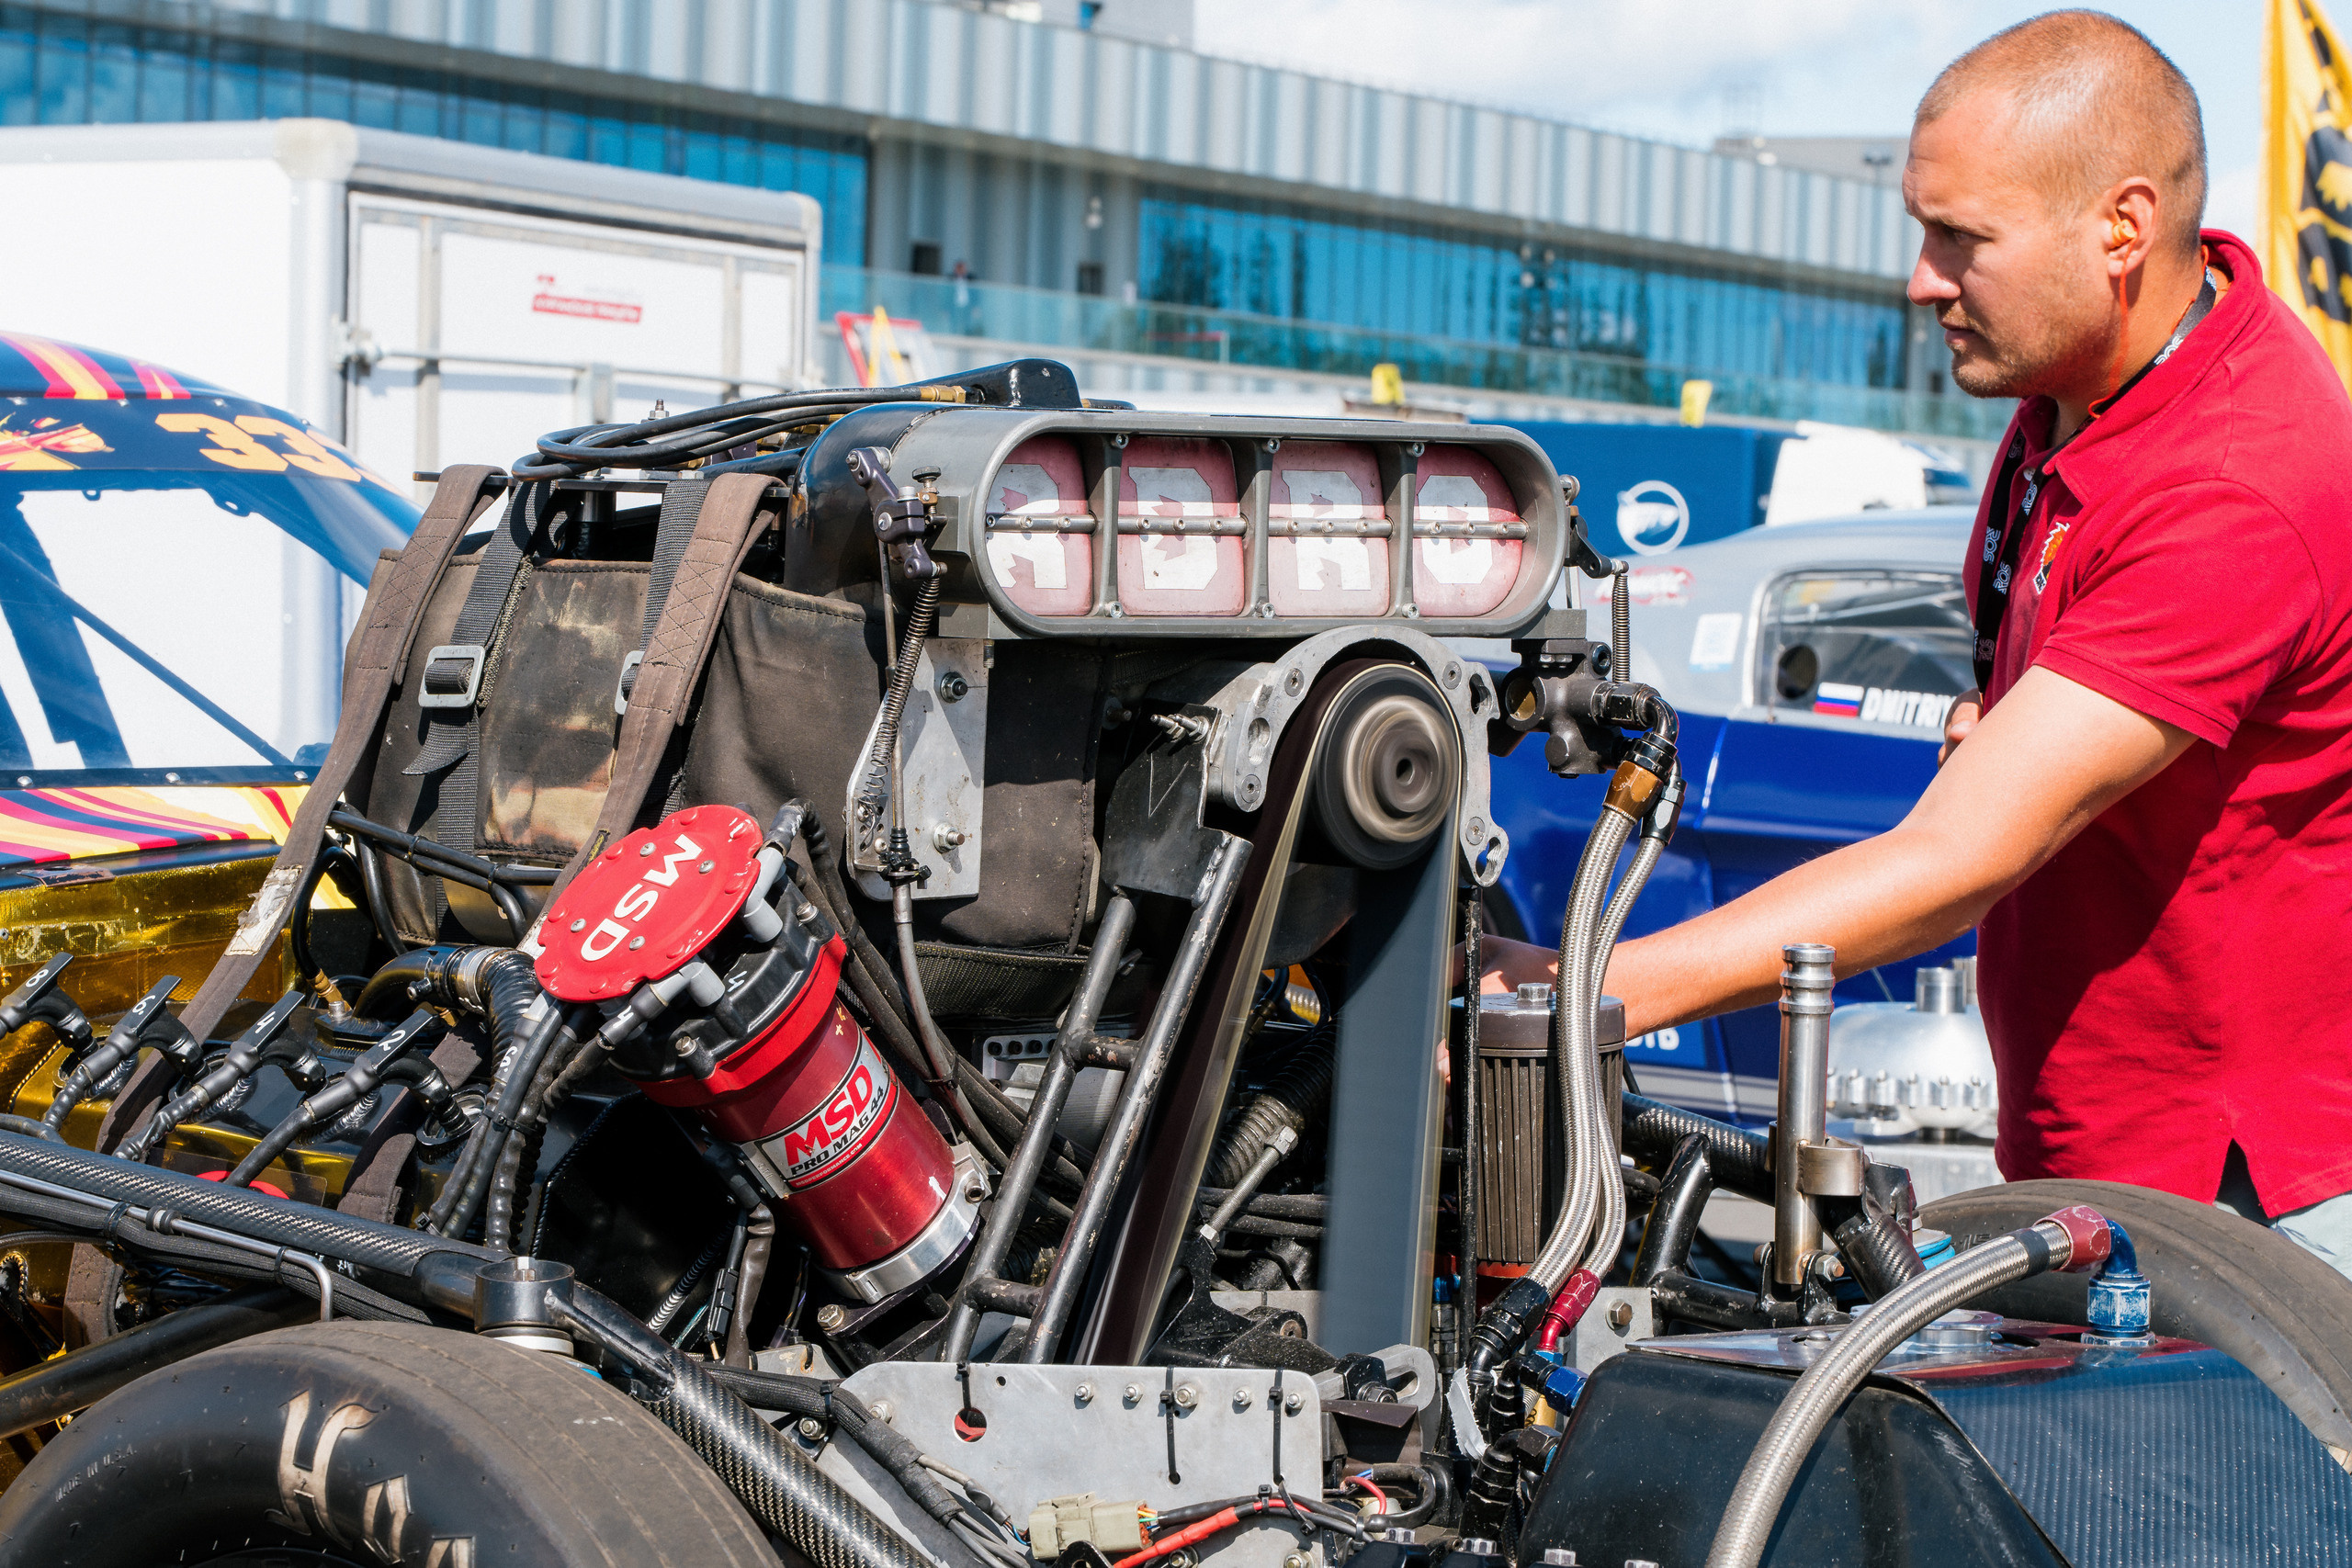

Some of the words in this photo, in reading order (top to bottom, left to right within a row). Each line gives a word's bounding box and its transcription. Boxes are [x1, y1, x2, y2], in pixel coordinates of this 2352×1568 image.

[1984, 525, 2001, 564] ROS
[581, 833, 704, 962] MSD
[25, 968, 50, 987] 8
[254, 1010, 276, 1034] 4
[378, 1029, 406, 1052] 2
[784, 1064, 873, 1167] MSD
[790, 1149, 830, 1176] PRO
[832, 1111, 870, 1154] MAG
[870, 1085, 884, 1113] 44
[796, 1143, 863, 1187] MSDPERFORMANCE.COM
[55, 1472, 82, 1504] MADE
[86, 1461, 98, 1479] IN
